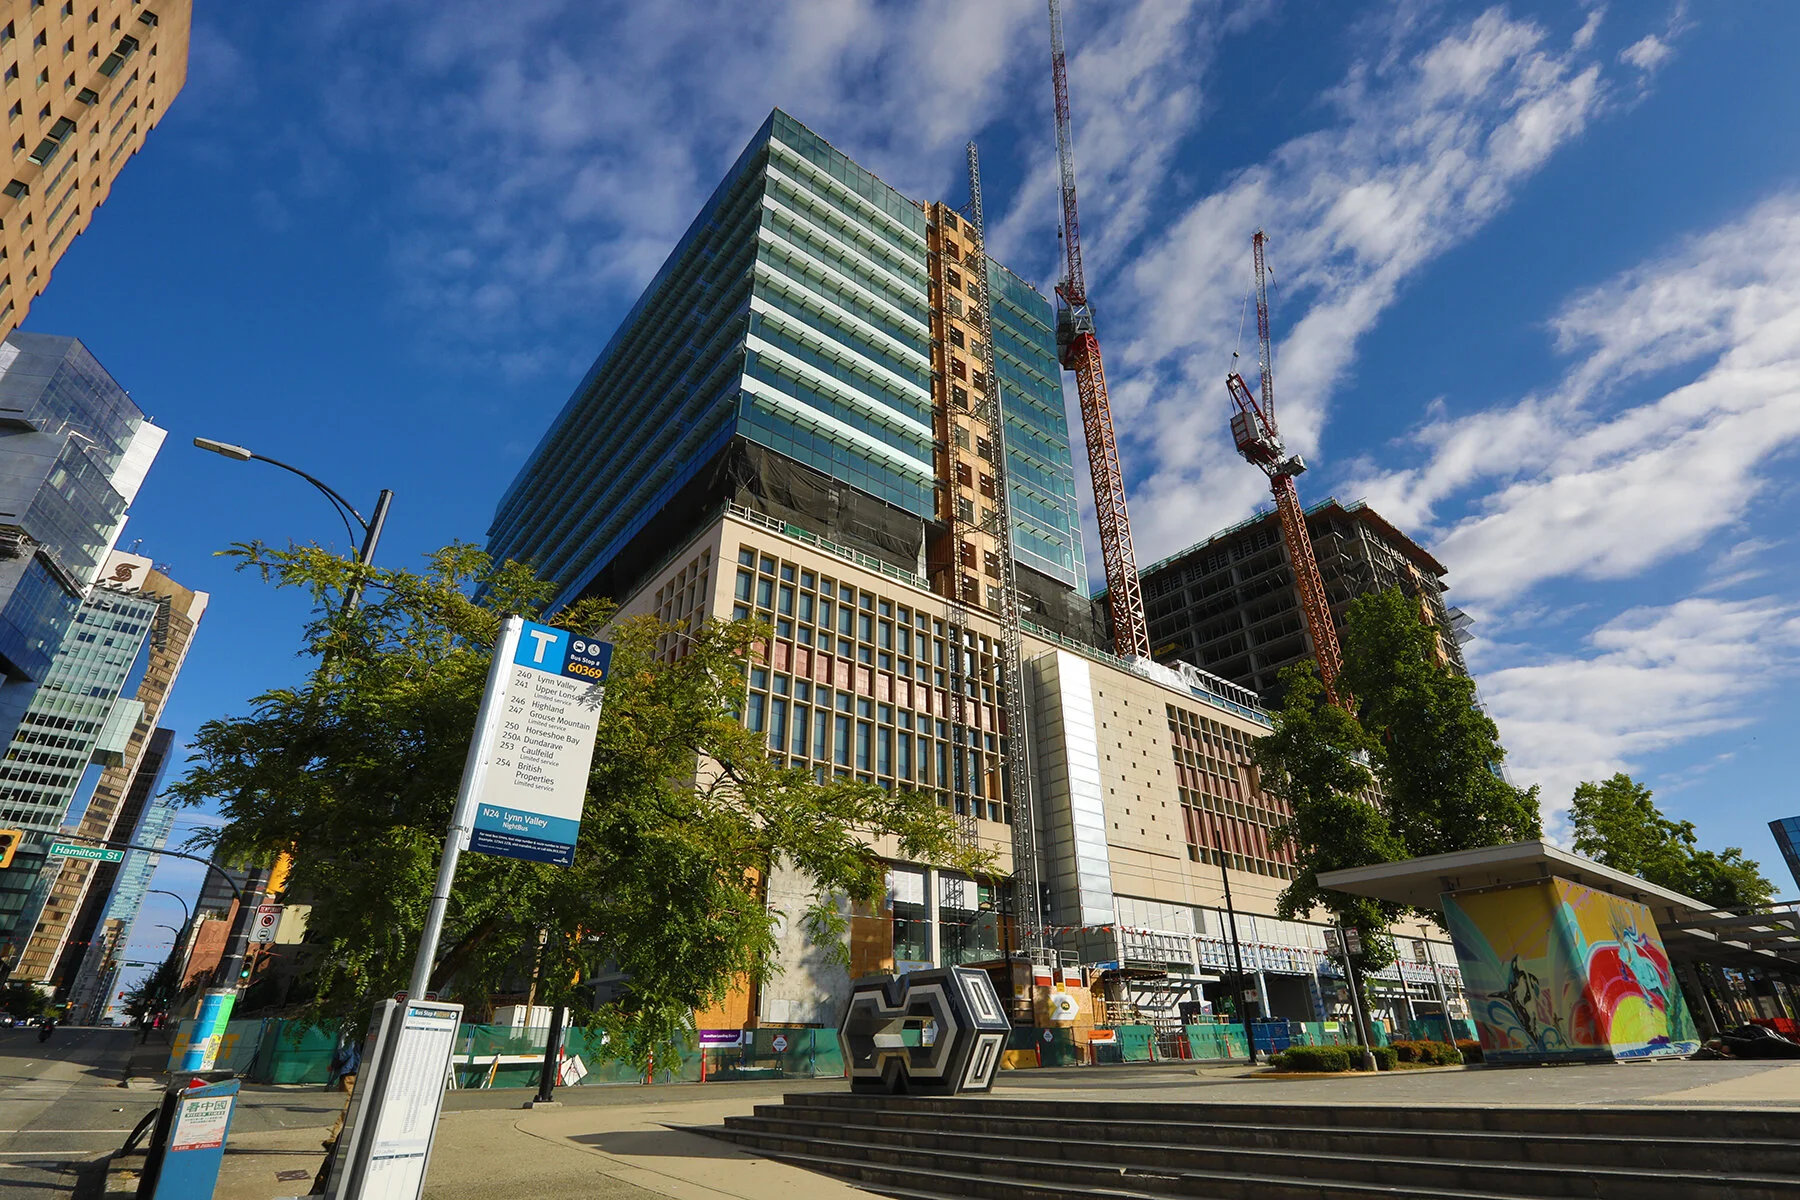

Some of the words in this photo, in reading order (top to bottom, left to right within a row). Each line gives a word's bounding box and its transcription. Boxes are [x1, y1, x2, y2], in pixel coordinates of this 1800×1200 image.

[530, 629, 558, 664] T
[570, 653, 581, 662] Bus
[582, 656, 595, 666] Stop
[568, 662, 603, 679] 60369
[514, 679, 528, 689] 241
[535, 684, 558, 696] Upper
[517, 670, 532, 680] 240
[537, 675, 555, 685] Lynn
[557, 679, 578, 693] Valley
[511, 695, 526, 705] 246
[532, 700, 565, 715] Highland
[534, 692, 553, 702] Limited
[554, 698, 572, 706] service
[508, 705, 524, 715] 247
[529, 710, 556, 722] Grouse
[557, 716, 591, 731] Mountain
[528, 718, 548, 728] Limited
[502, 731, 521, 742] 250A
[523, 736, 563, 751] Dundarave
[504, 721, 520, 731] 250
[526, 726, 565, 740] Horseshoe
[566, 735, 580, 746] Bay
[499, 741, 515, 750] 253
[521, 745, 554, 759] Caulfeild
[495, 757, 511, 767] 254
[517, 762, 542, 774] British
[520, 754, 540, 763] Limited
[540, 759, 560, 767] service
[514, 779, 534, 788] Limited
[535, 784, 554, 792] service
[515, 770, 555, 785] Properties
[483, 808, 500, 819] N24
[503, 811, 523, 823] Lynn
[524, 815, 548, 829] Valley
[502, 822, 529, 832] NightBus
[54, 845, 102, 858] Hamilton
[105, 851, 119, 860] St
